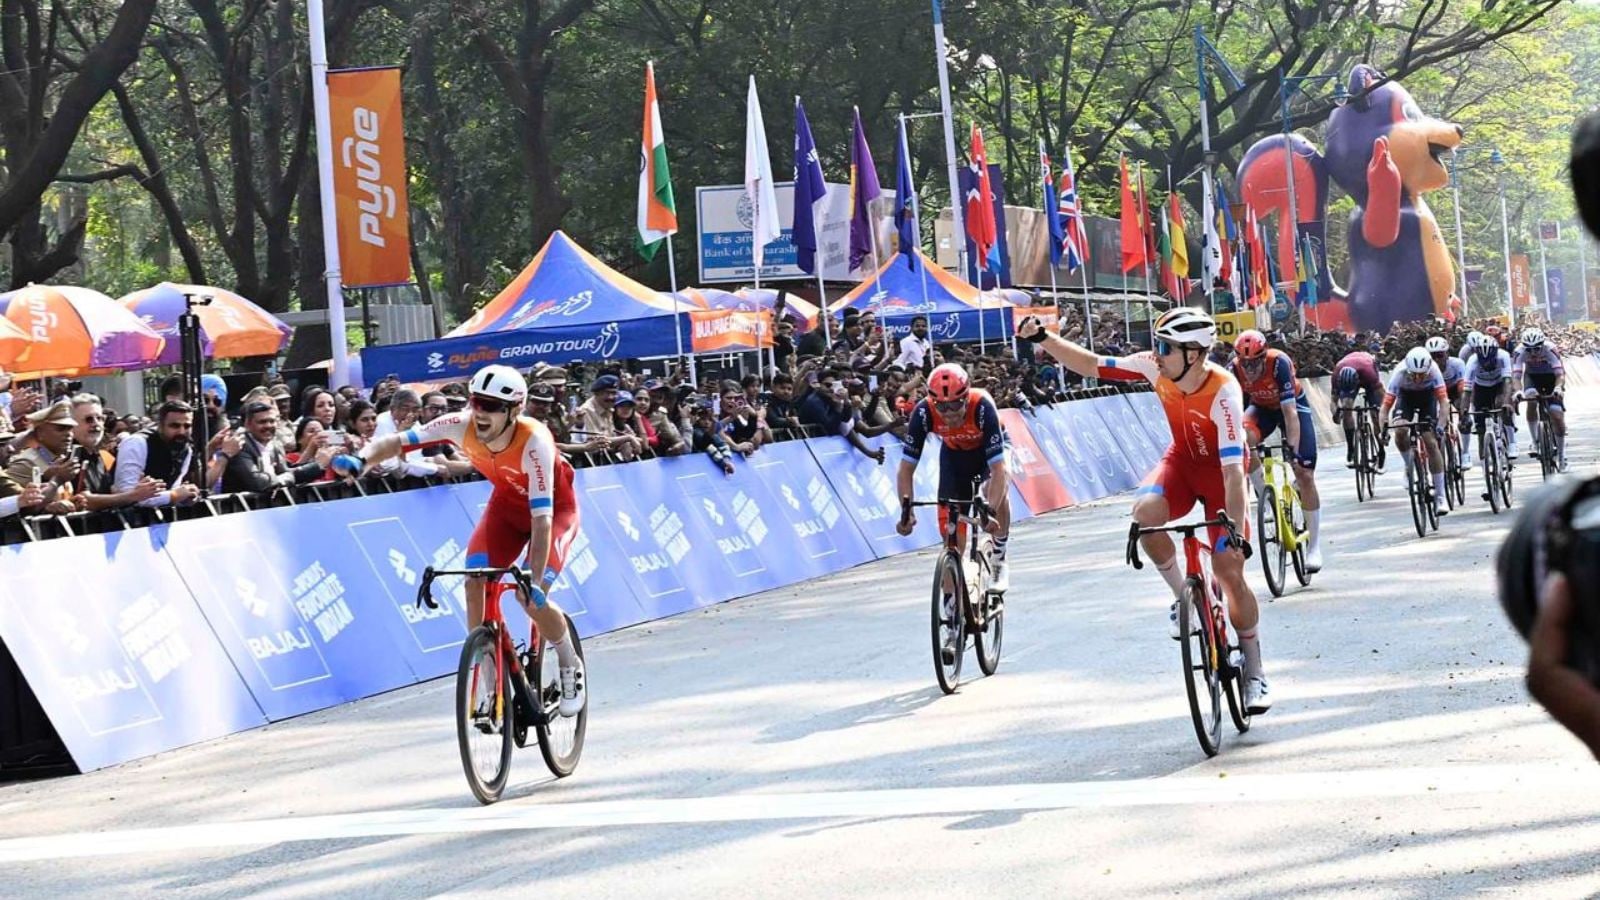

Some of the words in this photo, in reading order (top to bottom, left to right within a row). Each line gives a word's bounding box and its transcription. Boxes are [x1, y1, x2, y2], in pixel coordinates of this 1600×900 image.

[704, 247, 731, 258] Bank
[732, 246, 743, 257] of
[499, 342, 555, 358] GRAND
[555, 338, 597, 353] TOUR
[248, 627, 312, 659] BAJAJ
